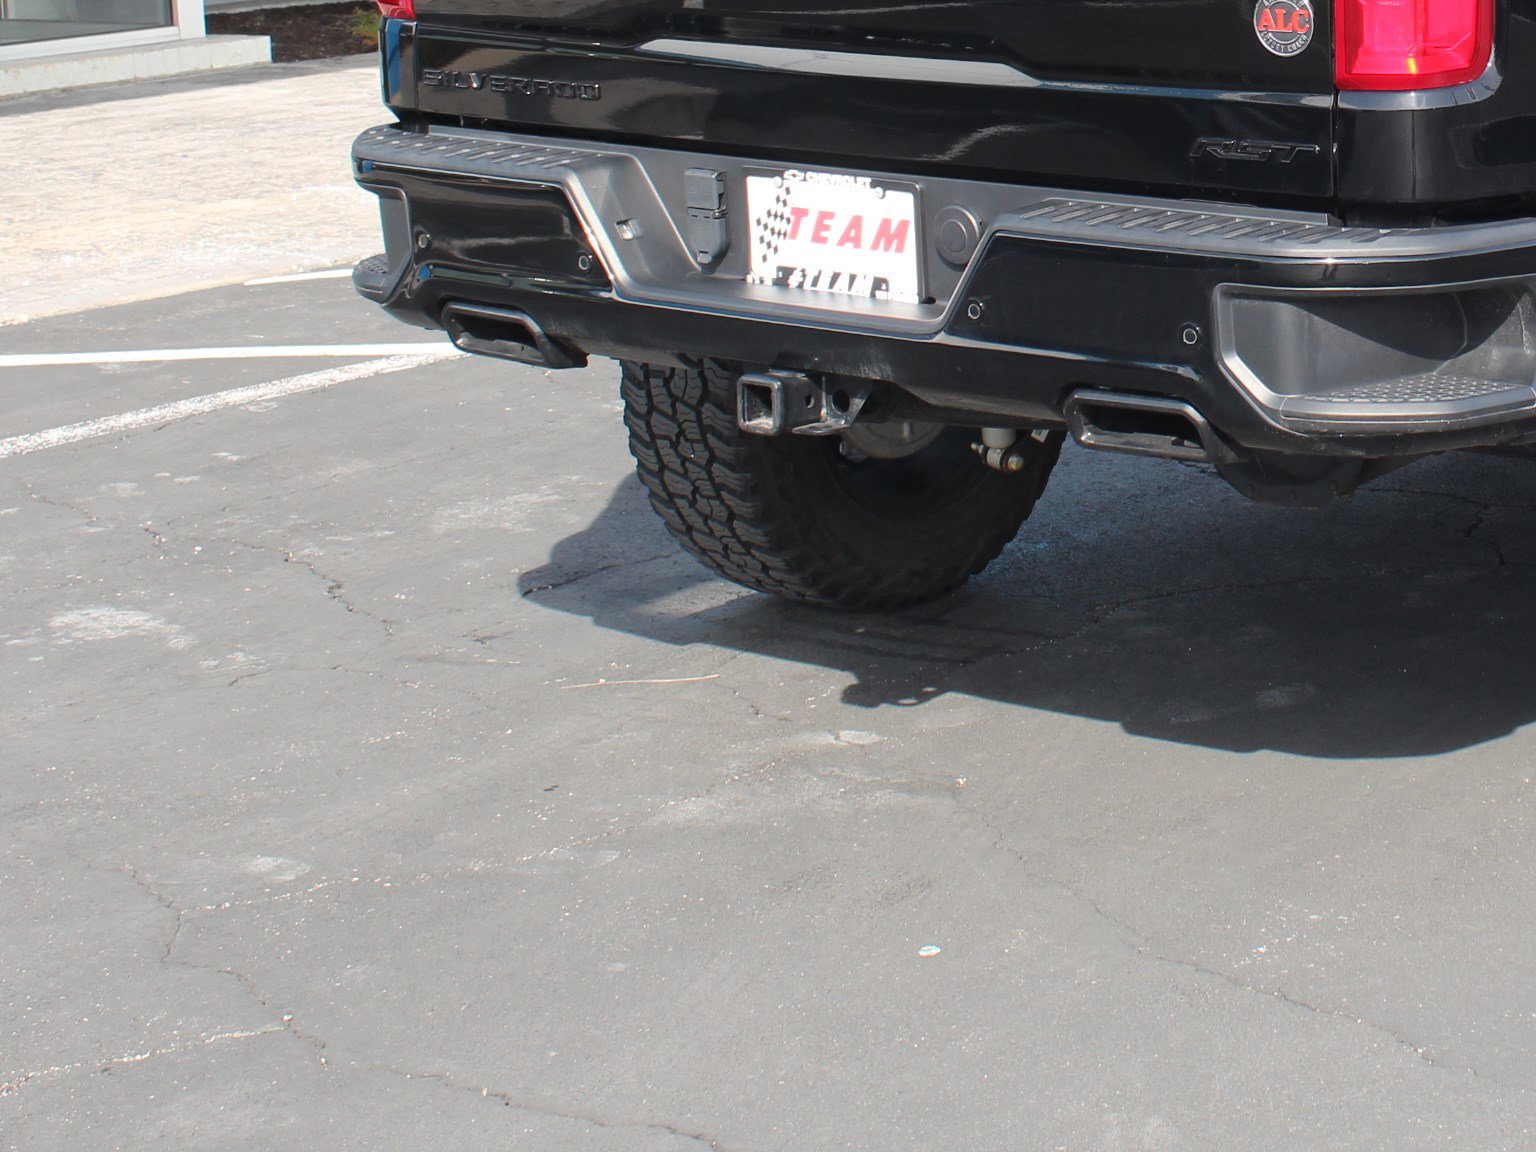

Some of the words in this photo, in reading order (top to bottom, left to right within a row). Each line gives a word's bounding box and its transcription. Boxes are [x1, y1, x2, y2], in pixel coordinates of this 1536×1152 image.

[1257, 7, 1310, 35] ALC
[423, 69, 601, 100] SILVERADO
[1188, 136, 1320, 164] RST
[787, 206, 911, 254] TEAM
